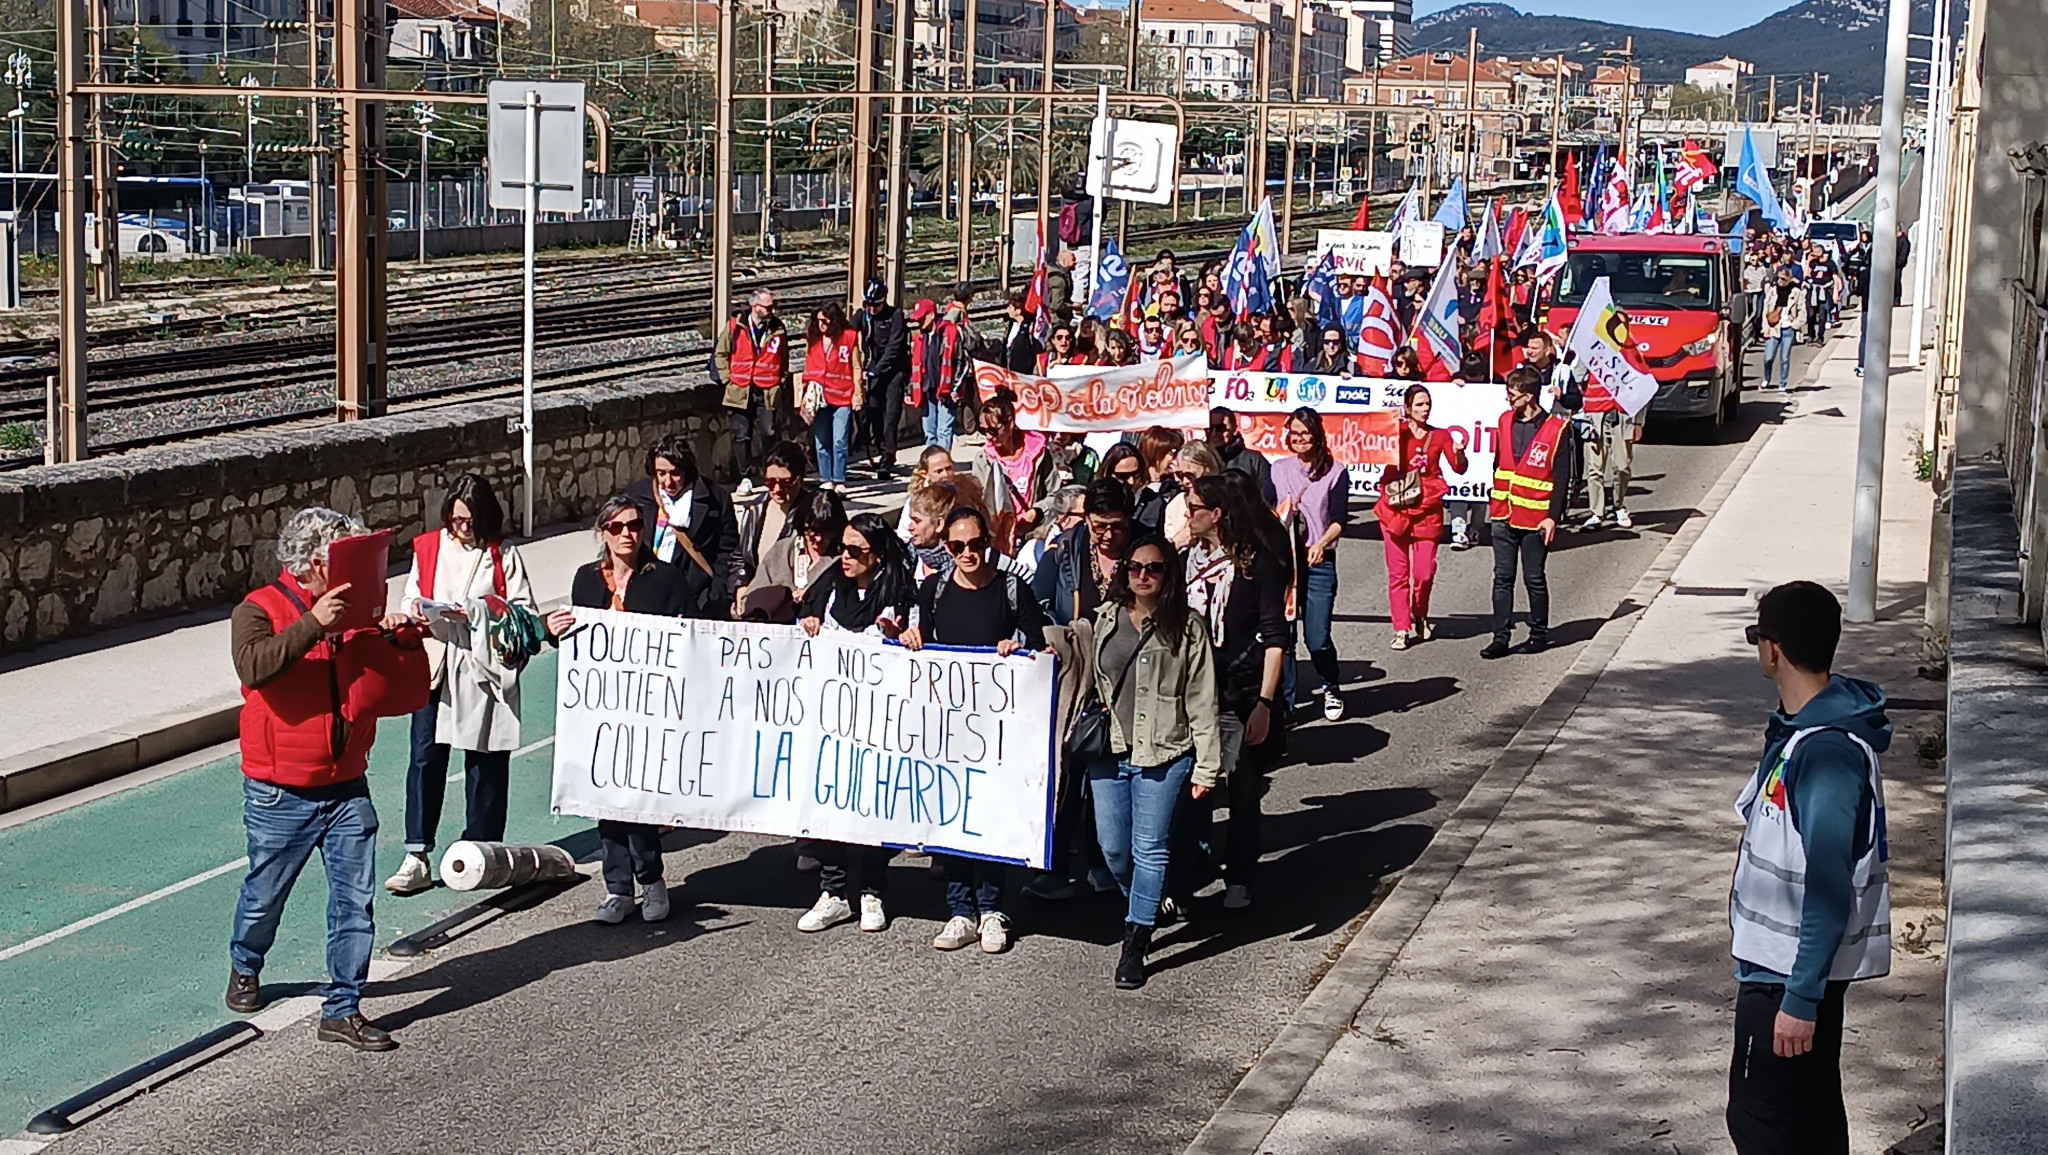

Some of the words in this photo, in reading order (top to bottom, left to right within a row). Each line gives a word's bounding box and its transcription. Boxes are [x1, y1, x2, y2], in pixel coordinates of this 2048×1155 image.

[1118, 362, 1208, 413] violence
[560, 622, 682, 669] TOUCHE
[718, 637, 772, 670] PAS
[797, 639, 812, 669] A
[838, 647, 883, 686] NOS
[563, 668, 686, 721] SOUTIEN
[718, 676, 734, 721] A
[755, 676, 804, 726] NOS
[591, 722, 718, 798] COLLEGE
[753, 729, 793, 802] LA
[814, 734, 988, 838] GUICHARDE
